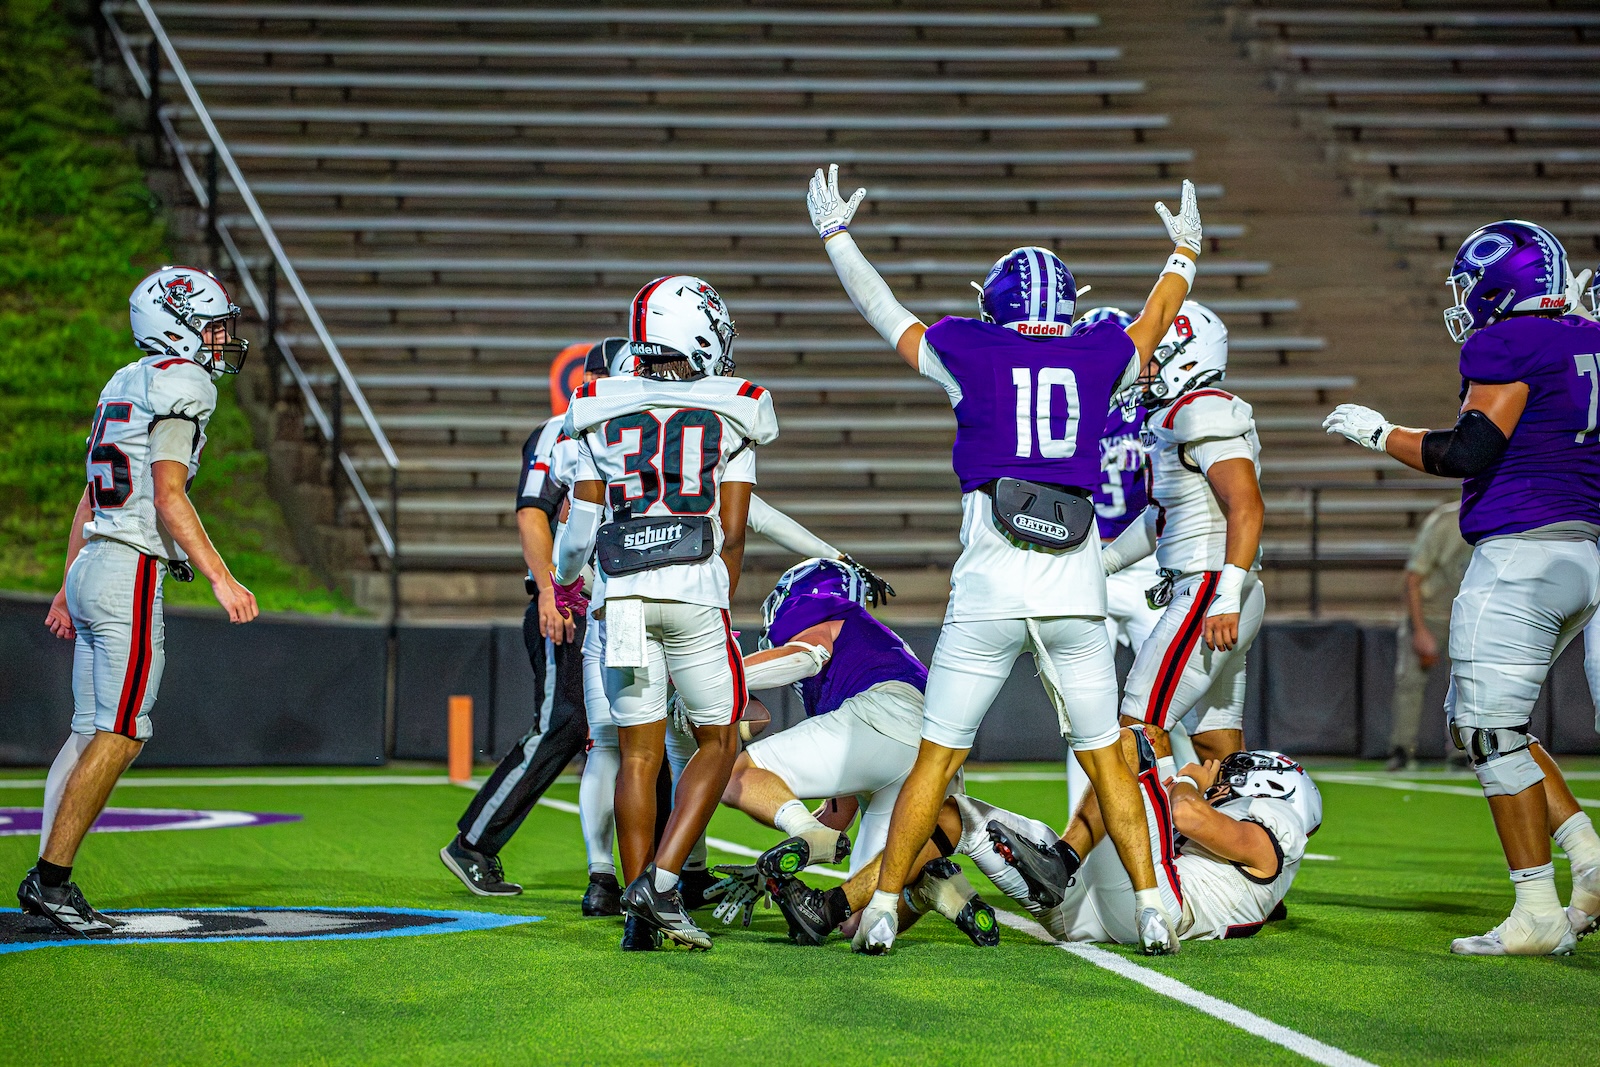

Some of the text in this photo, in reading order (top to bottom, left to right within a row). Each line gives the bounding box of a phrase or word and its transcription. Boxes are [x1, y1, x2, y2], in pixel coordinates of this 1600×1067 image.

[1017, 323, 1065, 336] Riddell
[1012, 366, 1080, 458] 10
[1573, 352, 1600, 443] 7
[605, 408, 722, 514] 30
[623, 523, 683, 548] schutt
[1018, 516, 1064, 538] BATTLE
